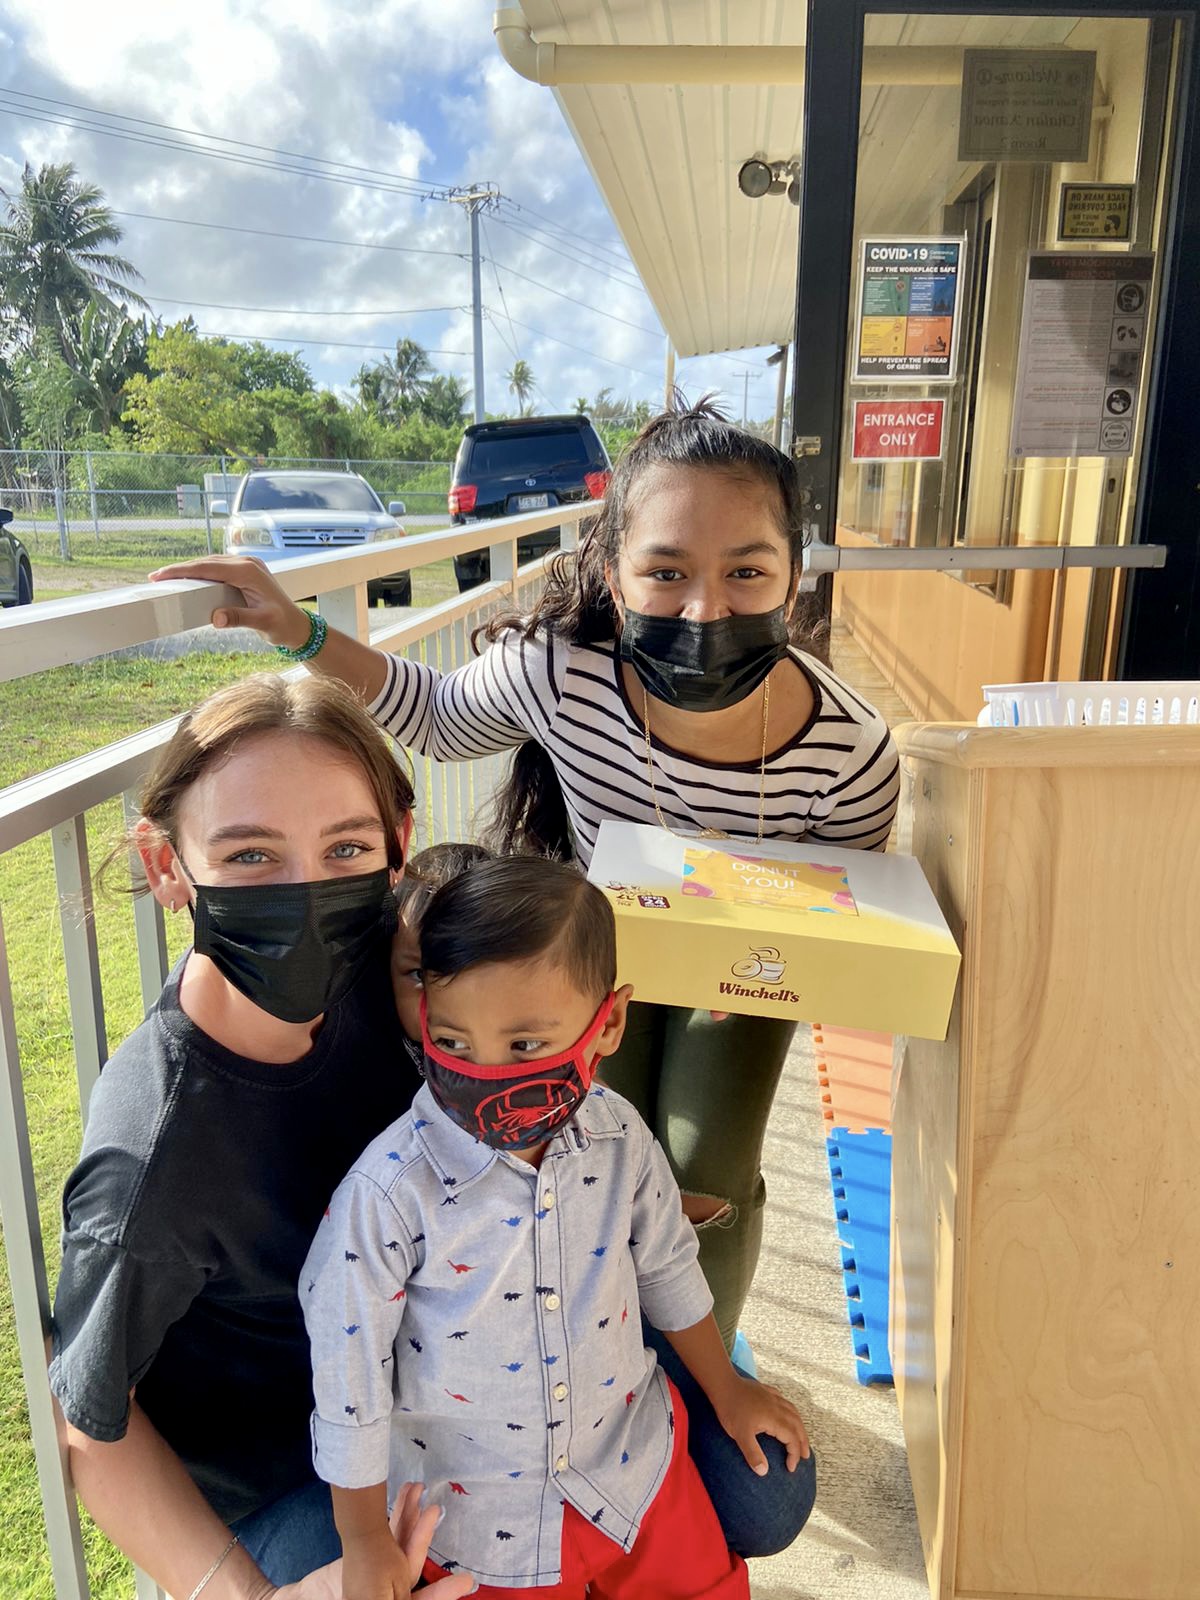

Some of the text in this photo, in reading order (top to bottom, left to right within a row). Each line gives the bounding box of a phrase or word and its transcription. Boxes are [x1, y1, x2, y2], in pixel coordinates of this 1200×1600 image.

[870, 247, 928, 261] COVID-19
[863, 412, 935, 427] ENTRANCE
[879, 432, 917, 447] ONLY
[731, 862, 800, 878] DONUT
[740, 875, 795, 890] YOU!
[644, 898, 666, 906] 24
[718, 981, 801, 1004] Winchell's
